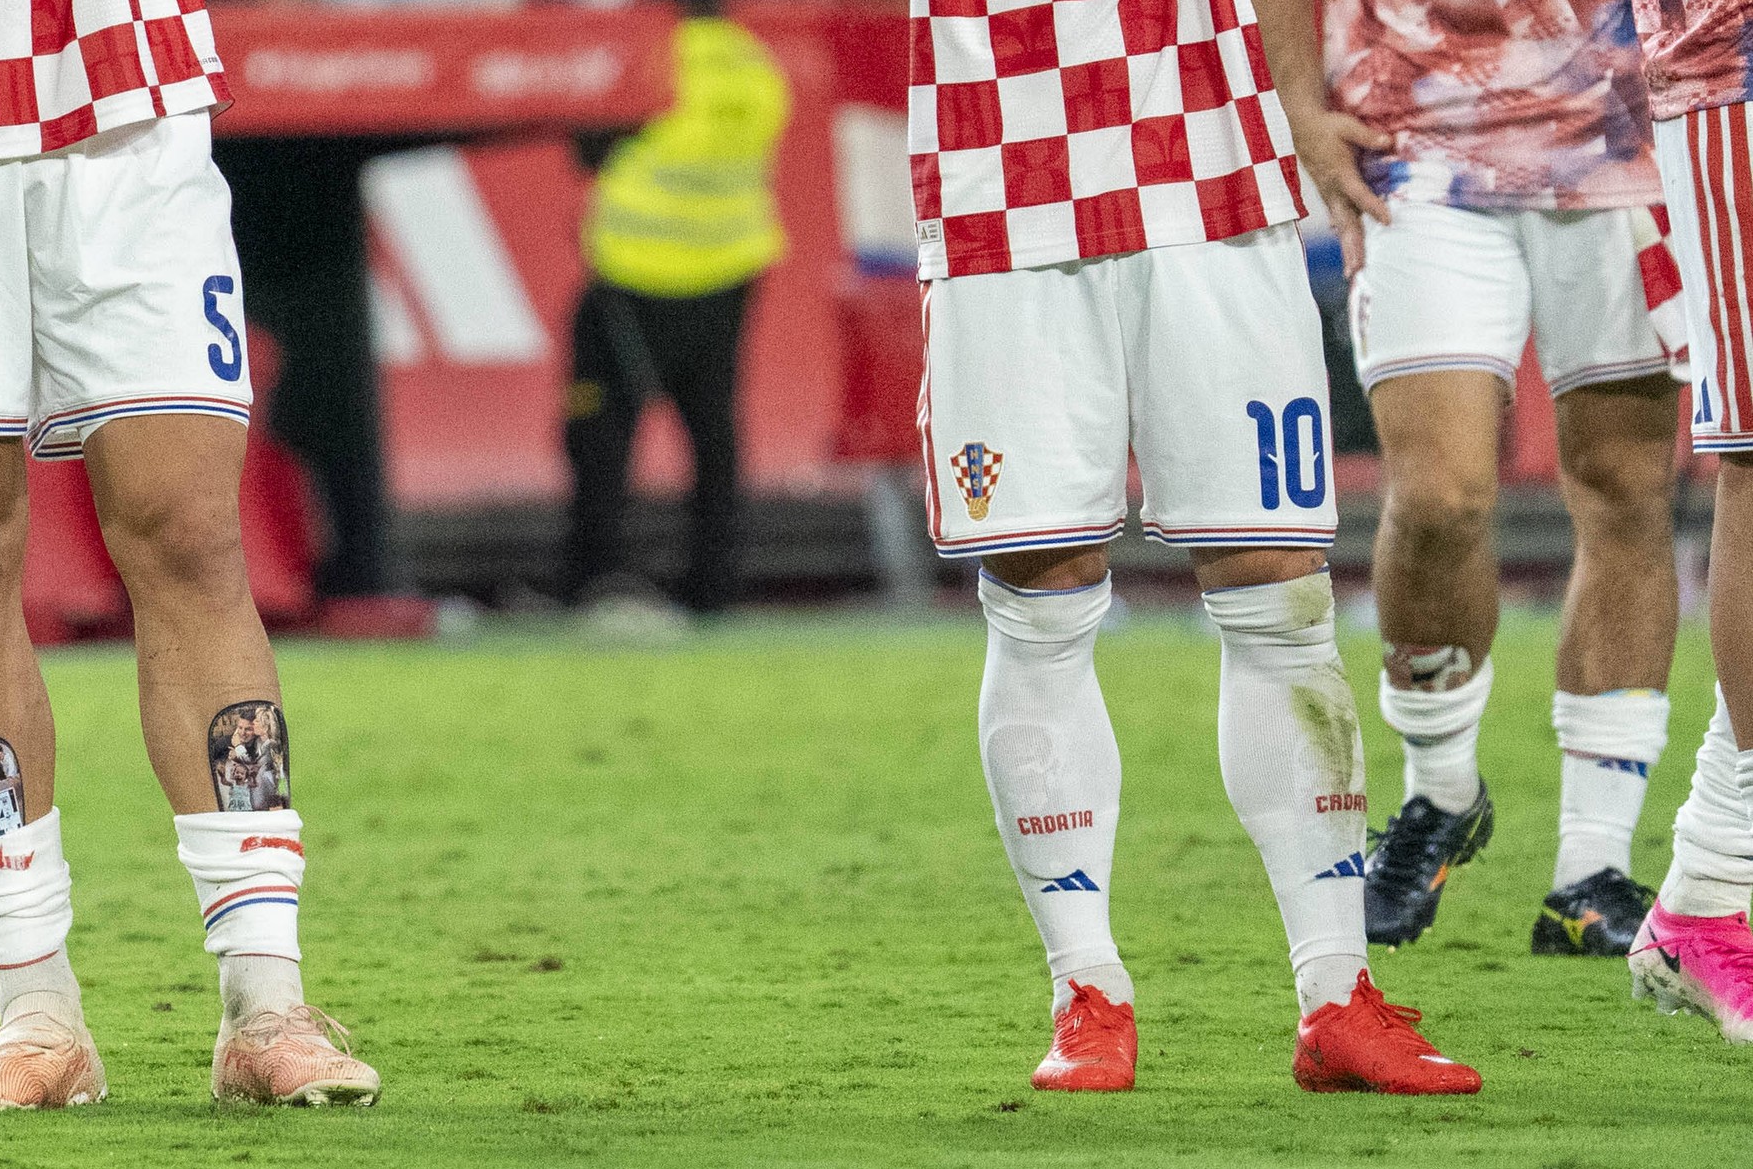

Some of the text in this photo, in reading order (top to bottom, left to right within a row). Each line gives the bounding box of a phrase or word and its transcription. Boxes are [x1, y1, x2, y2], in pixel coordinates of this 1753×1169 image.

[202, 274, 243, 382] 5
[1245, 396, 1327, 511] 10
[1016, 809, 1093, 835] CROATIA
